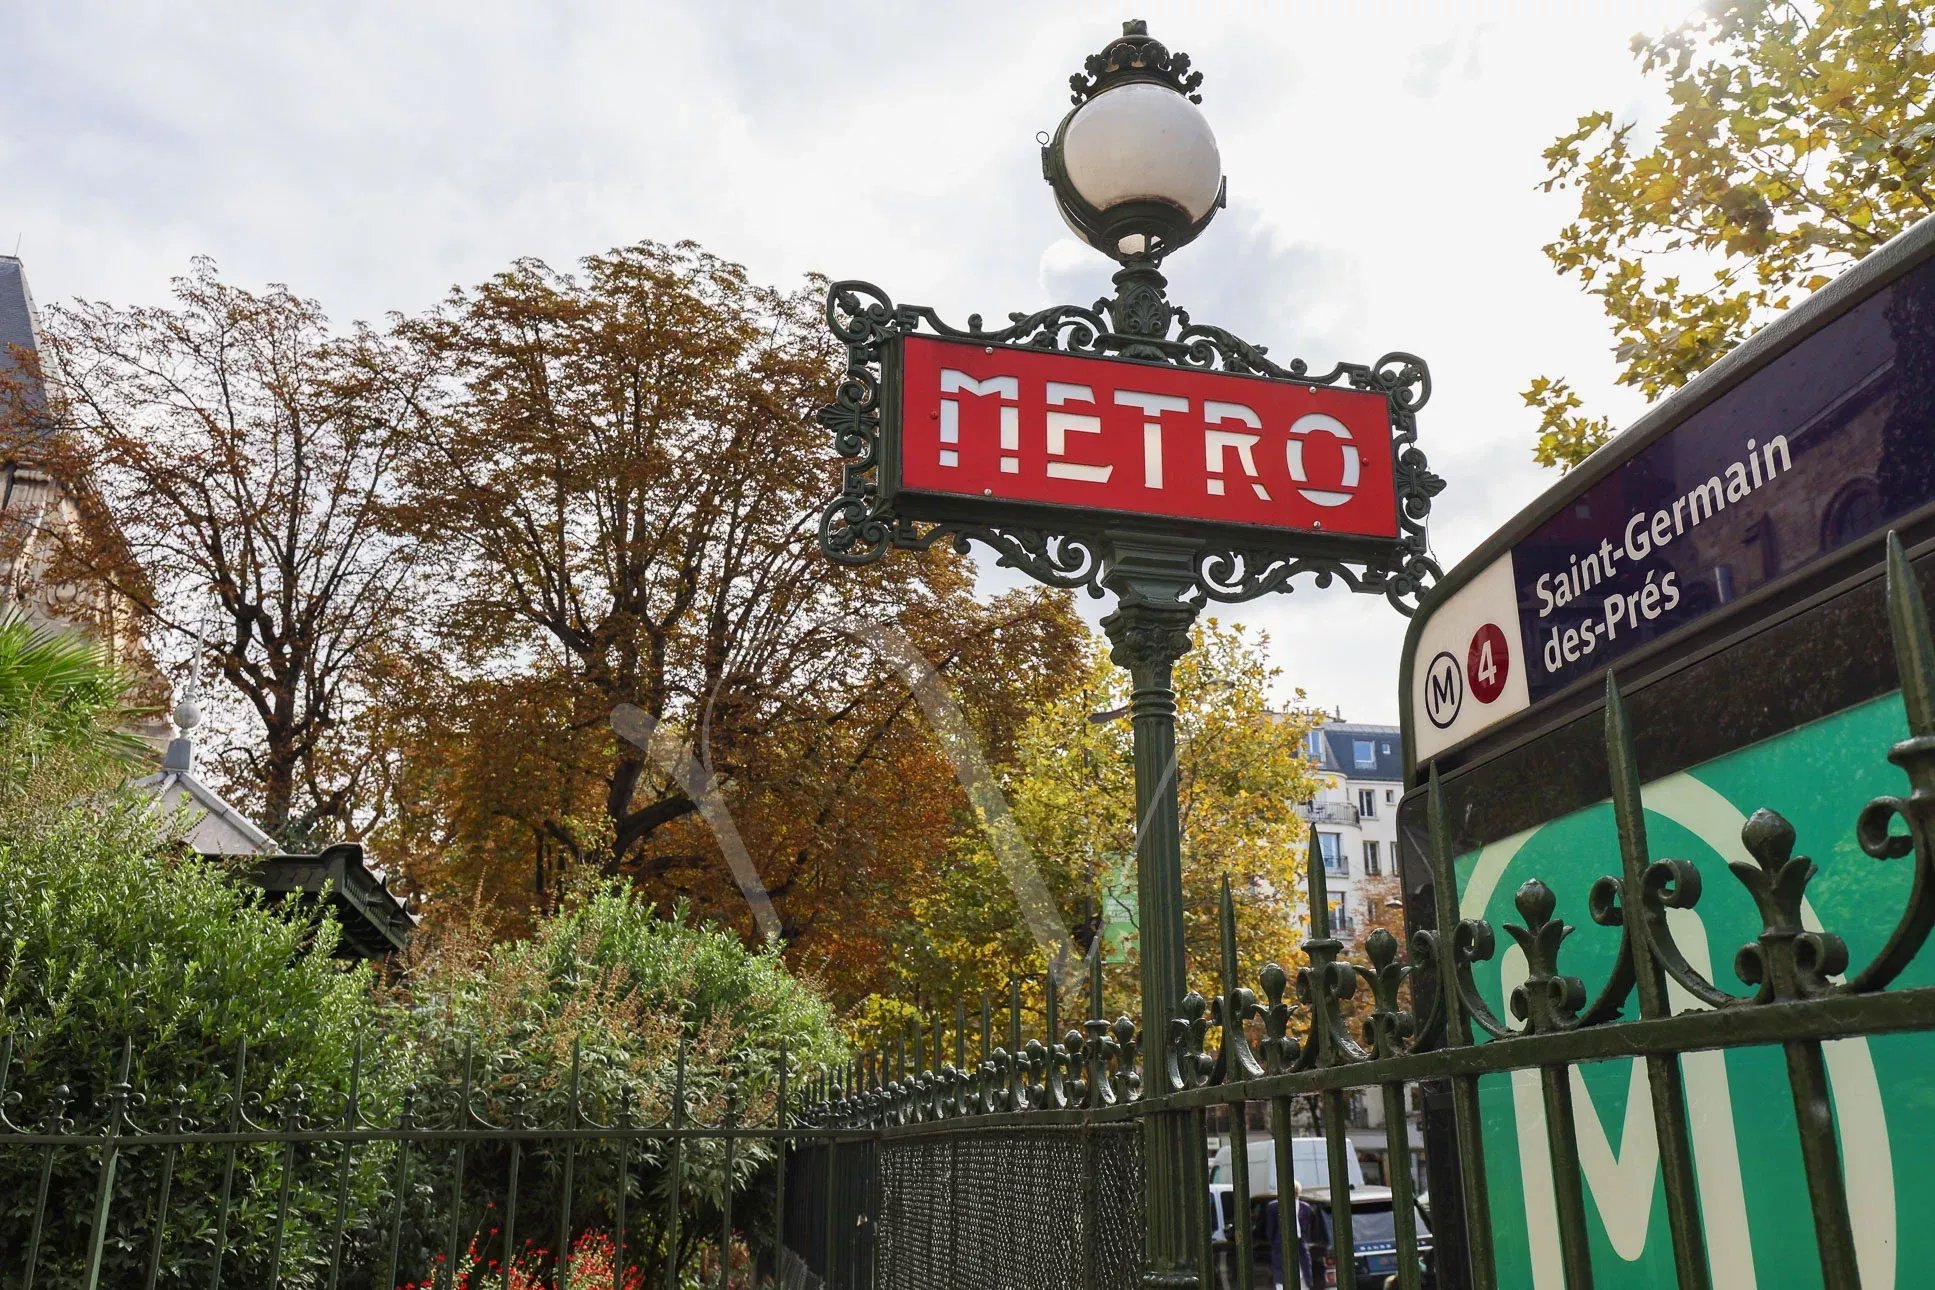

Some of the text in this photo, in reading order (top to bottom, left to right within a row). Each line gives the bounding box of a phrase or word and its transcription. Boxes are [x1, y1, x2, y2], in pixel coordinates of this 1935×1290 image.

[939, 368, 1361, 507] METRO
[1537, 435, 1792, 618] Saint-Germain
[1432, 639, 1497, 715] M 4
[1544, 569, 1680, 672] des-Prés
[1501, 908, 1758, 1290] M
